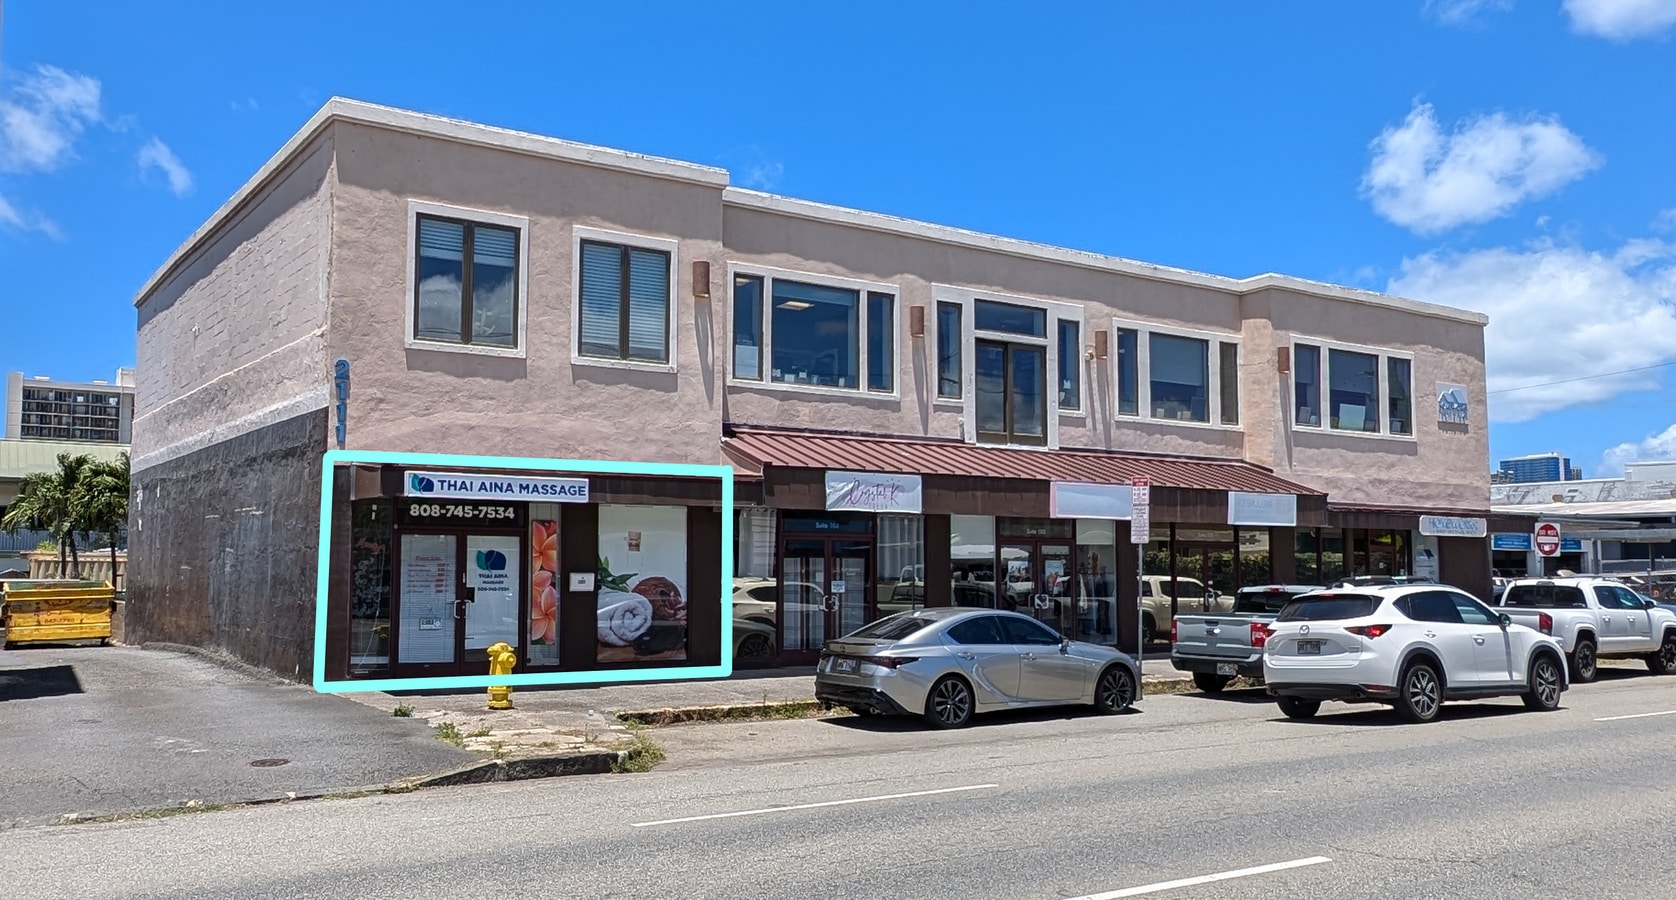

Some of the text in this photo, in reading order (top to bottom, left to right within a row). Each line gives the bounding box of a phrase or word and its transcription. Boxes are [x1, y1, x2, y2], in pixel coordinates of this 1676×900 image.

[335, 360, 350, 443] 2111
[437, 479, 586, 496] THAI AINA MASSAGE
[409, 504, 515, 519] 808-745-7534
